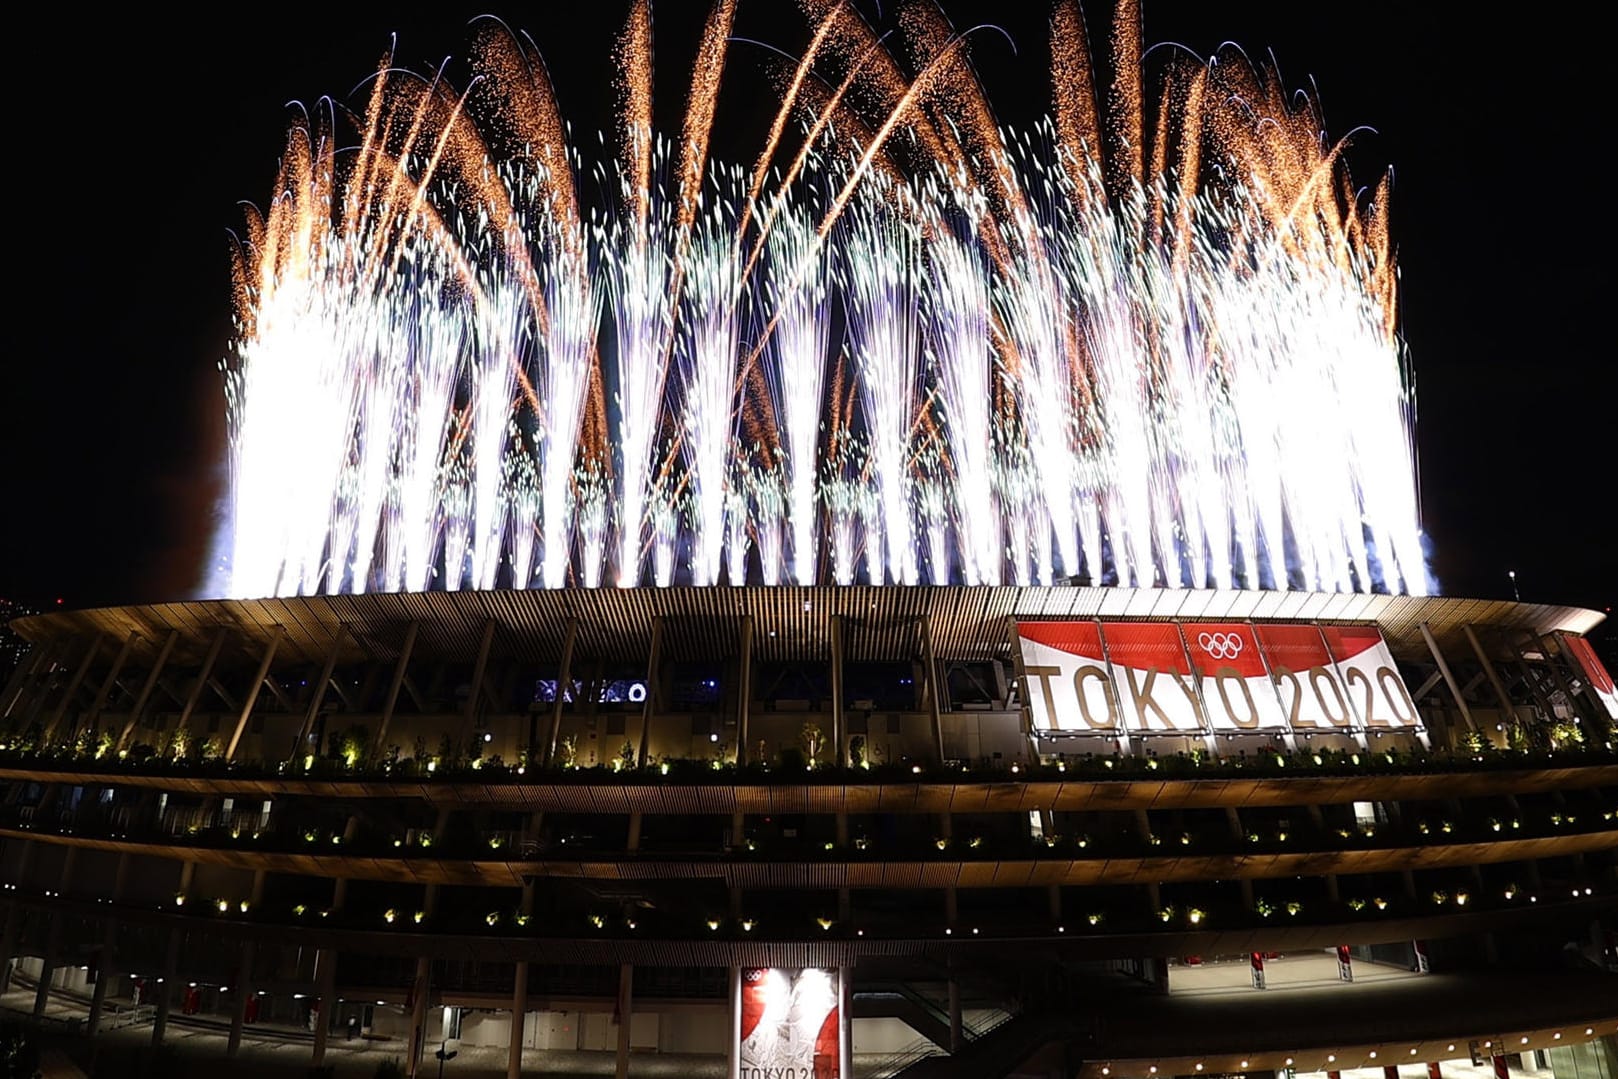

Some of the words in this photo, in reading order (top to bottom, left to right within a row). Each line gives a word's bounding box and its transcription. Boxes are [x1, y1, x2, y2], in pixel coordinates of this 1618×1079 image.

[1024, 665, 1259, 730] TOKYO
[1273, 665, 1418, 727] 2020
[740, 1067, 795, 1079] TOKYO
